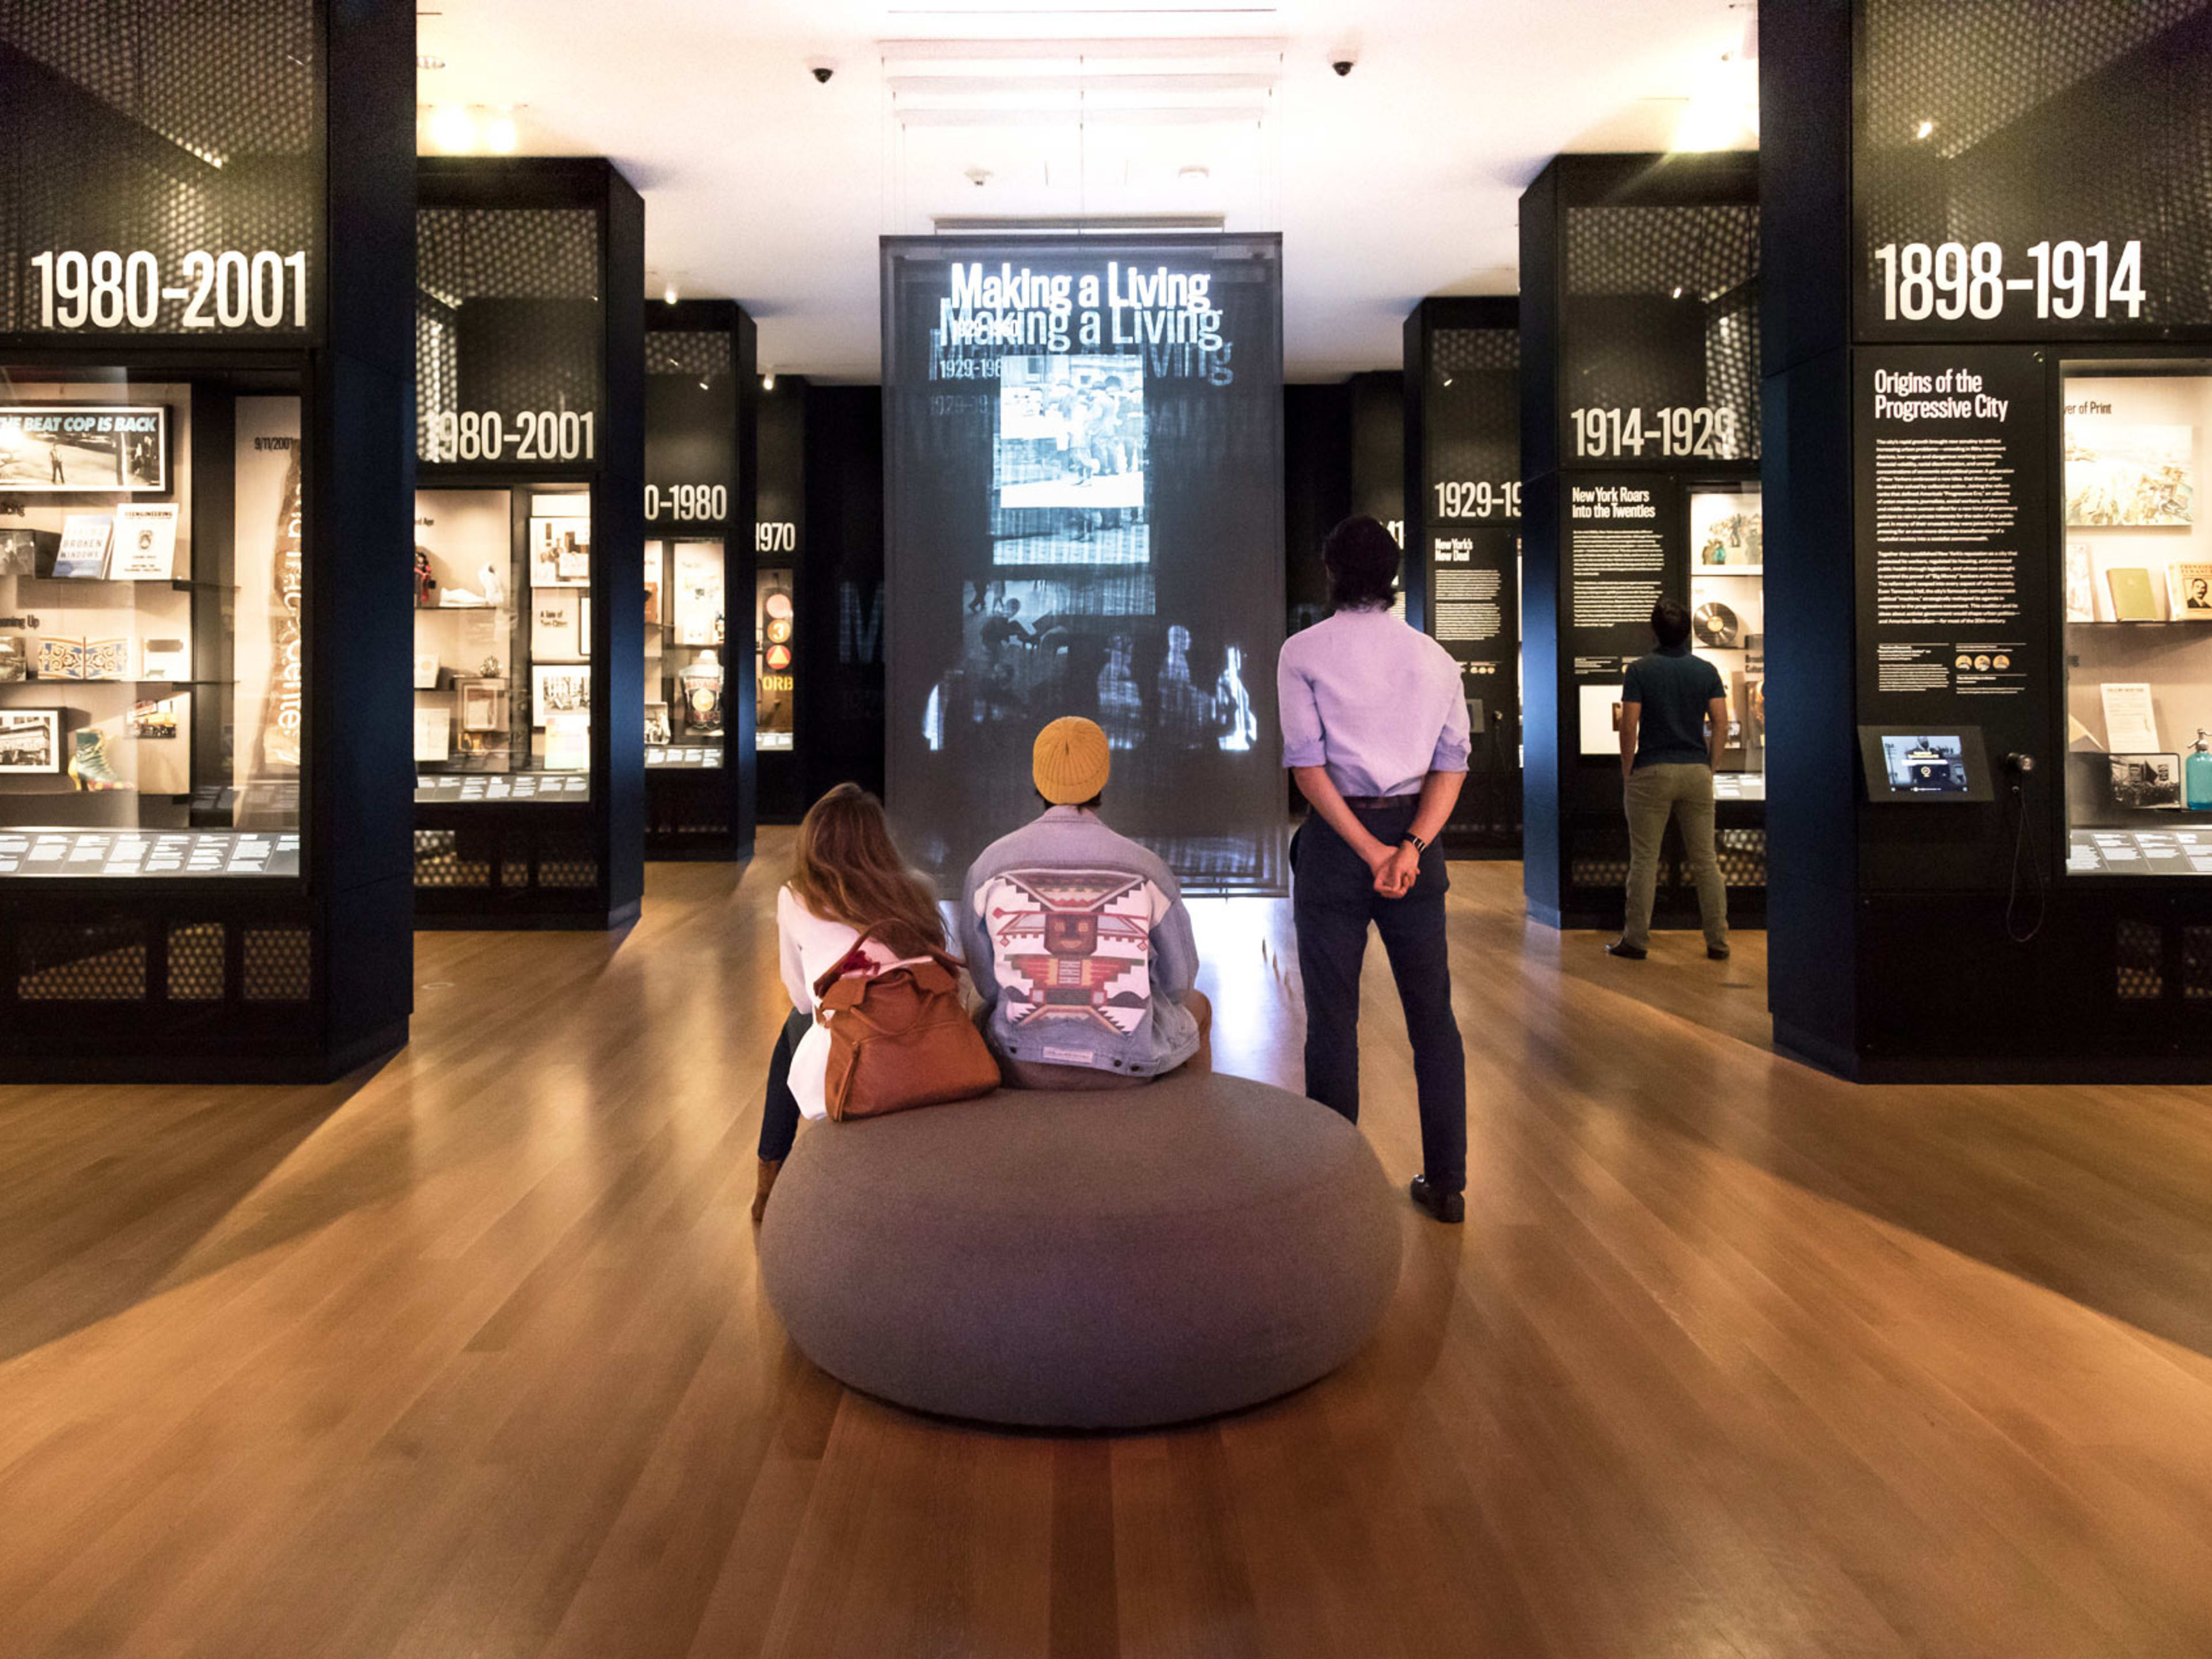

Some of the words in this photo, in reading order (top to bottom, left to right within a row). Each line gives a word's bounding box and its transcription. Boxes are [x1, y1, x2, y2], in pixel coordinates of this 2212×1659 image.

[31, 250, 306, 328] 1980-2001
[952, 263, 1073, 313] Making
[1078, 274, 1099, 308] a
[1108, 262, 1211, 313] Living
[1874, 240, 2146, 320] 1898-1914
[940, 297, 1071, 352] Making
[1079, 310, 1101, 345] a
[1112, 300, 1223, 351] Living
[1874, 369, 1932, 397] Origins
[1936, 369, 1955, 394] of
[1956, 369, 1983, 393] the
[1874, 395, 1971, 422] Progressive
[1975, 393, 2009, 422] City
[2078, 402, 2089, 414] of
[2090, 402, 2112, 414] Print
[24, 417, 62, 431] BEAT
[63, 417, 96, 432] COP
[97, 417, 112, 431] IS
[114, 417, 157, 431] BACK
[1571, 407, 1736, 457] 1914-1929
[1572, 487, 1595, 502] New
[1595, 487, 1618, 502] York
[1620, 487, 1650, 502] Roars
[1572, 504, 1592, 518] Into
[1593, 503, 1611, 518] the
[1611, 502, 1656, 518] Twenties
[27, 615, 40, 630] Up
[773, 623, 785, 639] 3
